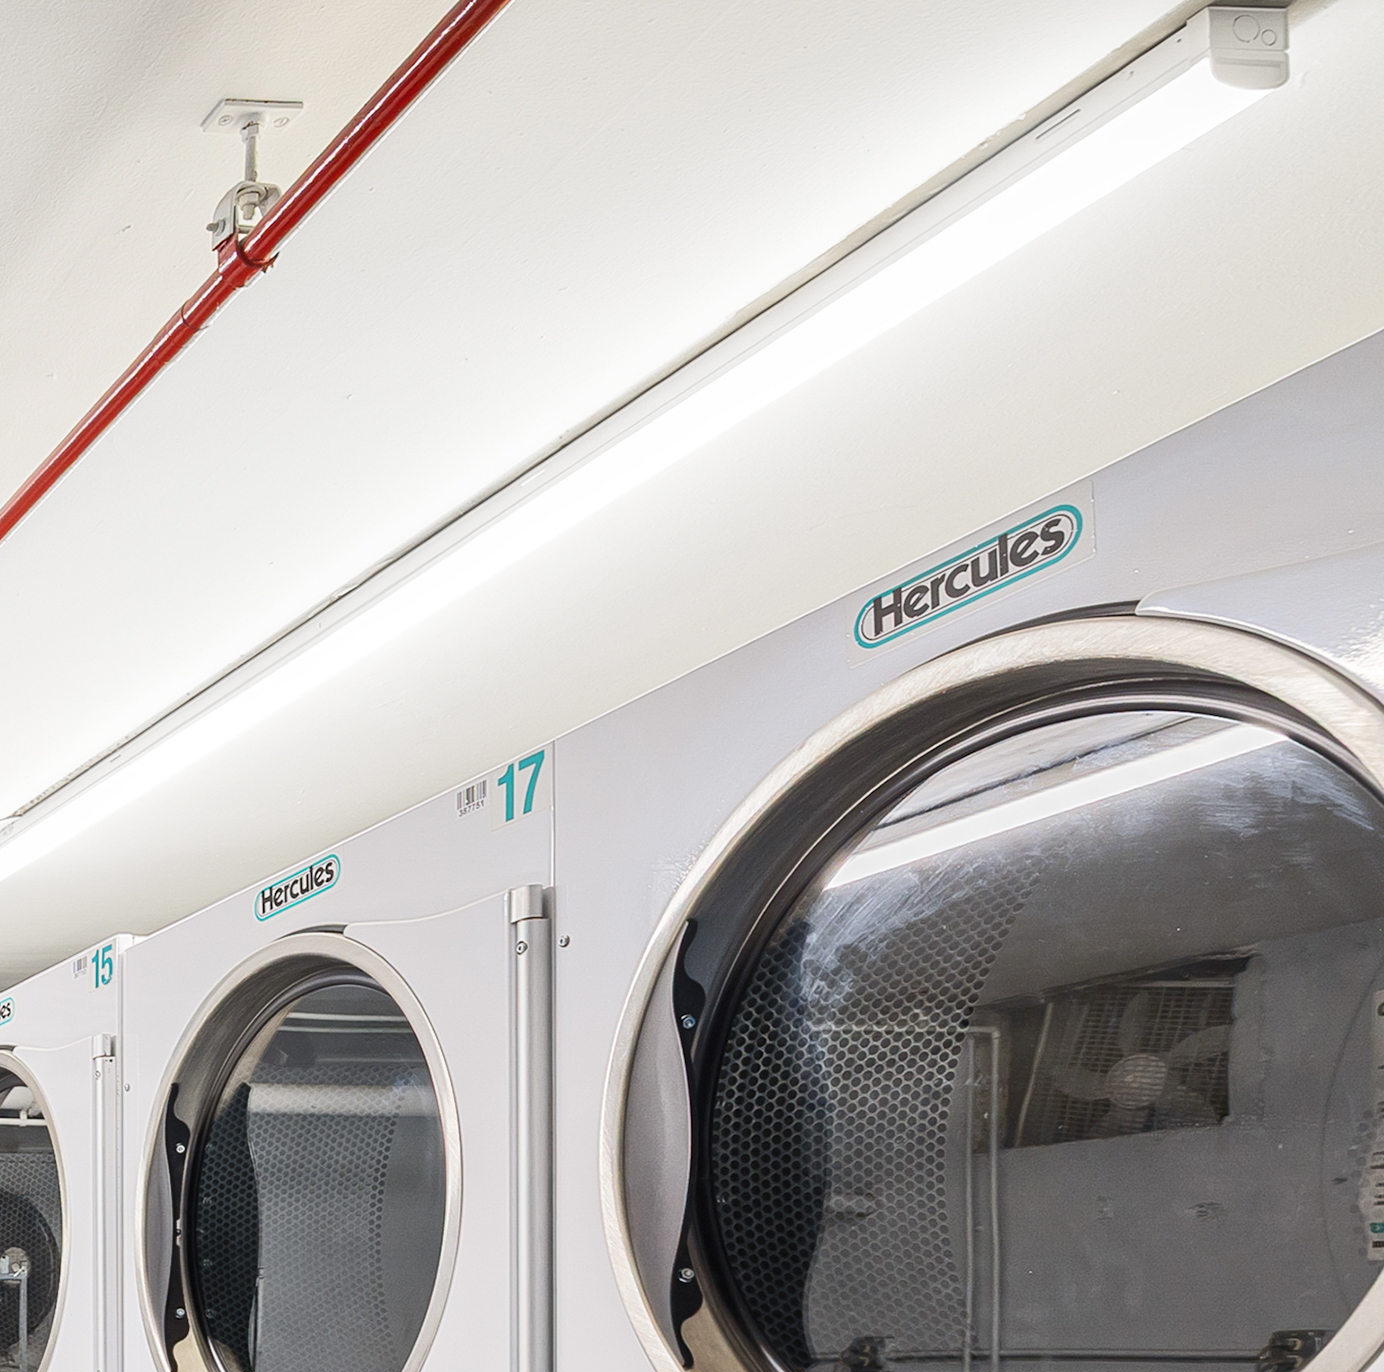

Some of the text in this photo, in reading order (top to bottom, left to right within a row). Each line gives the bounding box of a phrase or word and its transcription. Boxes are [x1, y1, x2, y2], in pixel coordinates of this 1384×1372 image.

[871, 517, 1066, 639] Hercules
[497, 749, 545, 822] 17
[261, 861, 334, 914] Hercules
[92, 944, 113, 988] 15
